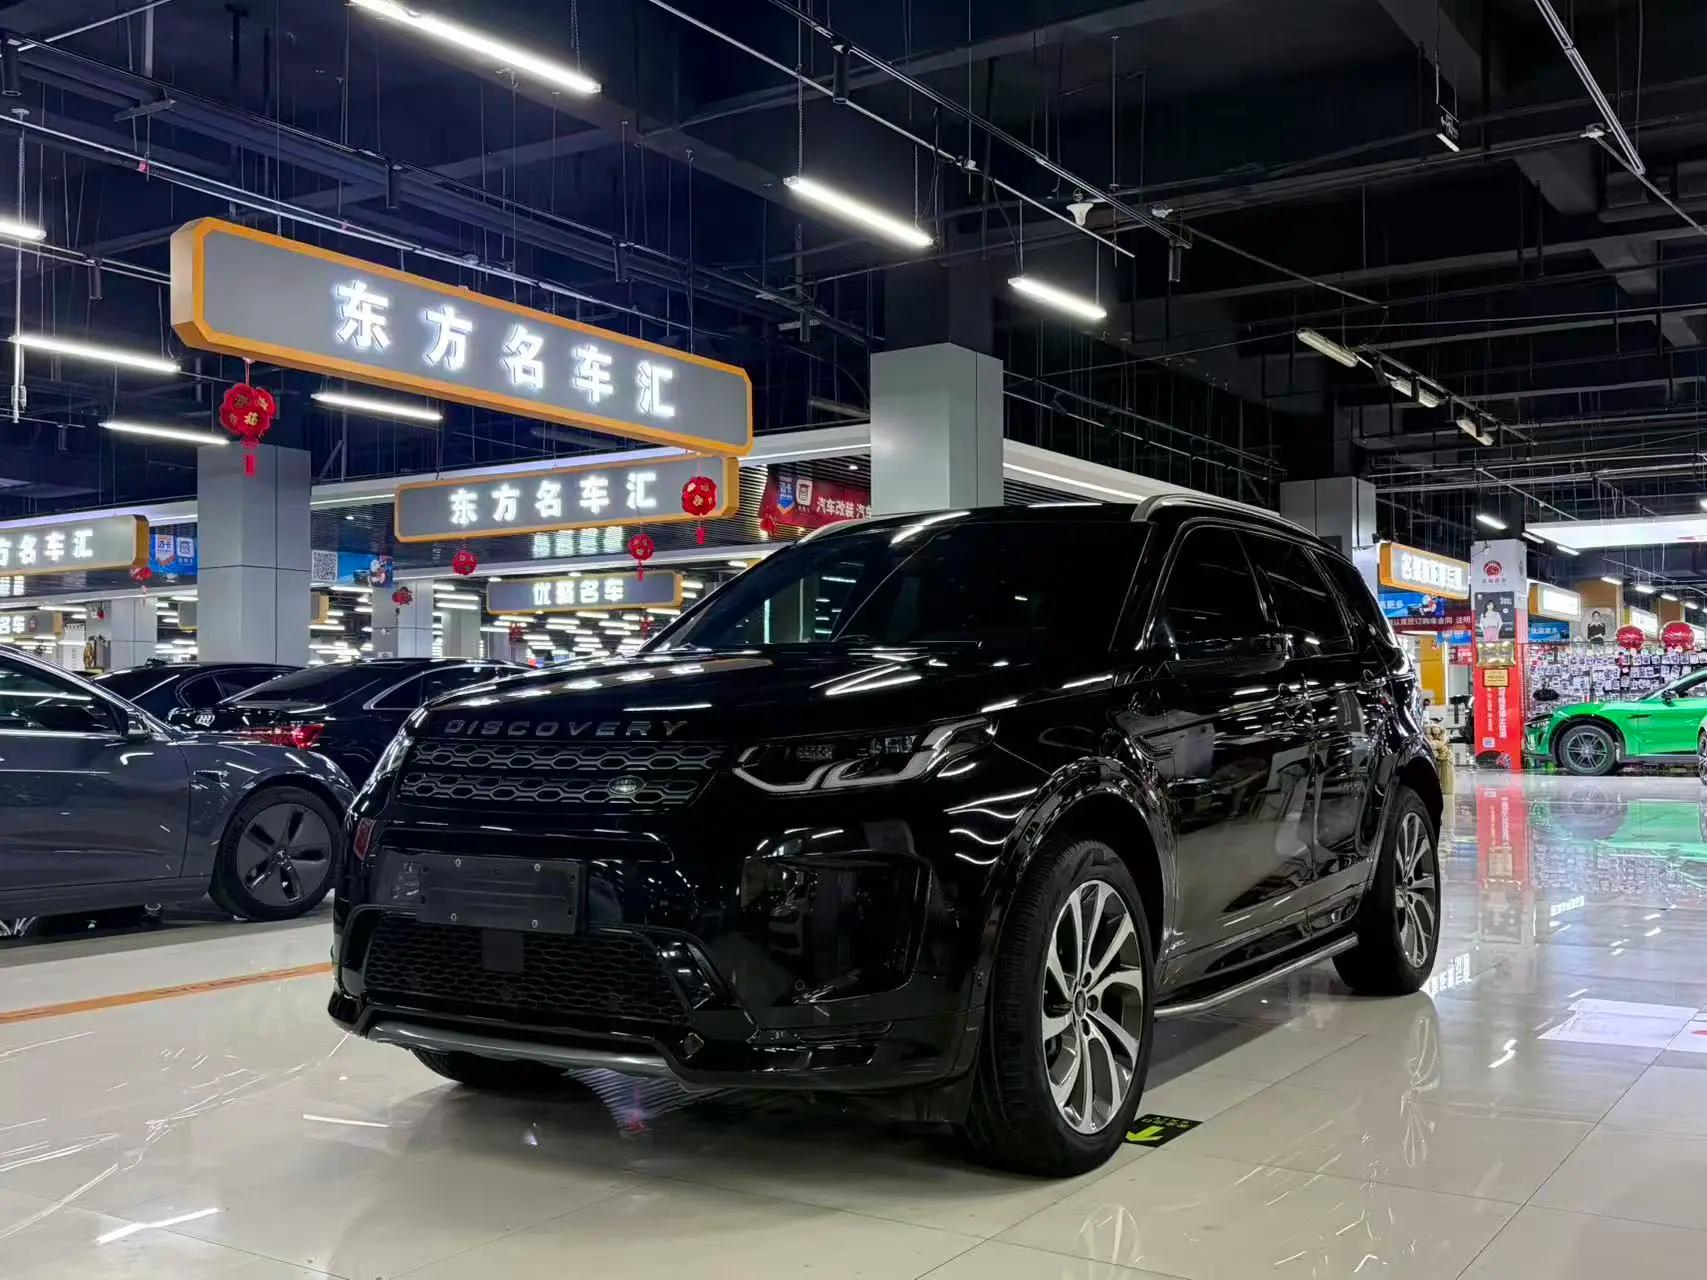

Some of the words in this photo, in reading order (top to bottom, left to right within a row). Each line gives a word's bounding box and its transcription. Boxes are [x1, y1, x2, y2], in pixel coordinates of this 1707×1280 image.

[334, 279, 676, 419] 东方名车汇
[449, 471, 658, 526] 东方名车汇
[816, 496, 855, 518] 汽车改装
[444, 719, 688, 737] DISCOVERY
